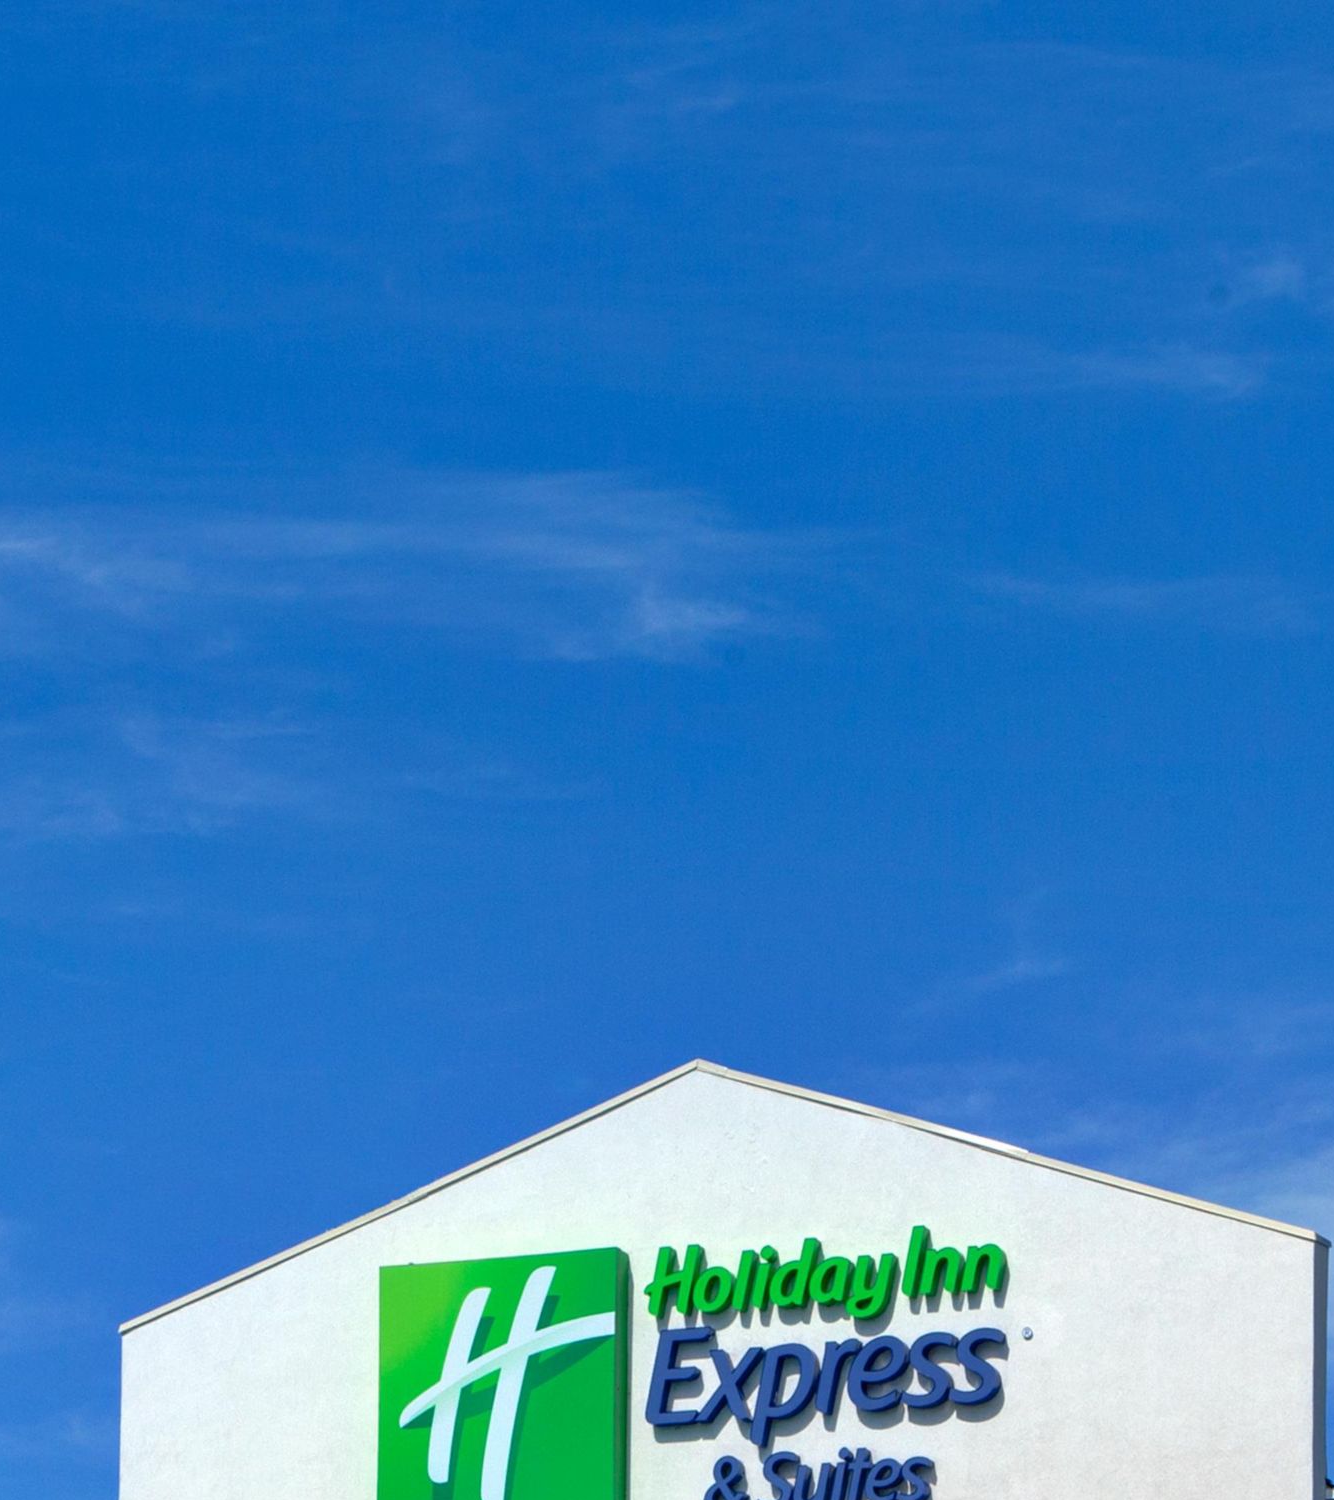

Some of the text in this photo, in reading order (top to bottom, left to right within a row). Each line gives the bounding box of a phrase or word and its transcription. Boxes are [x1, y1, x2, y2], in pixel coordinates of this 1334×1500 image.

[644, 1225, 1008, 1320] Holiday Inn
[645, 1325, 1007, 1448] Express
